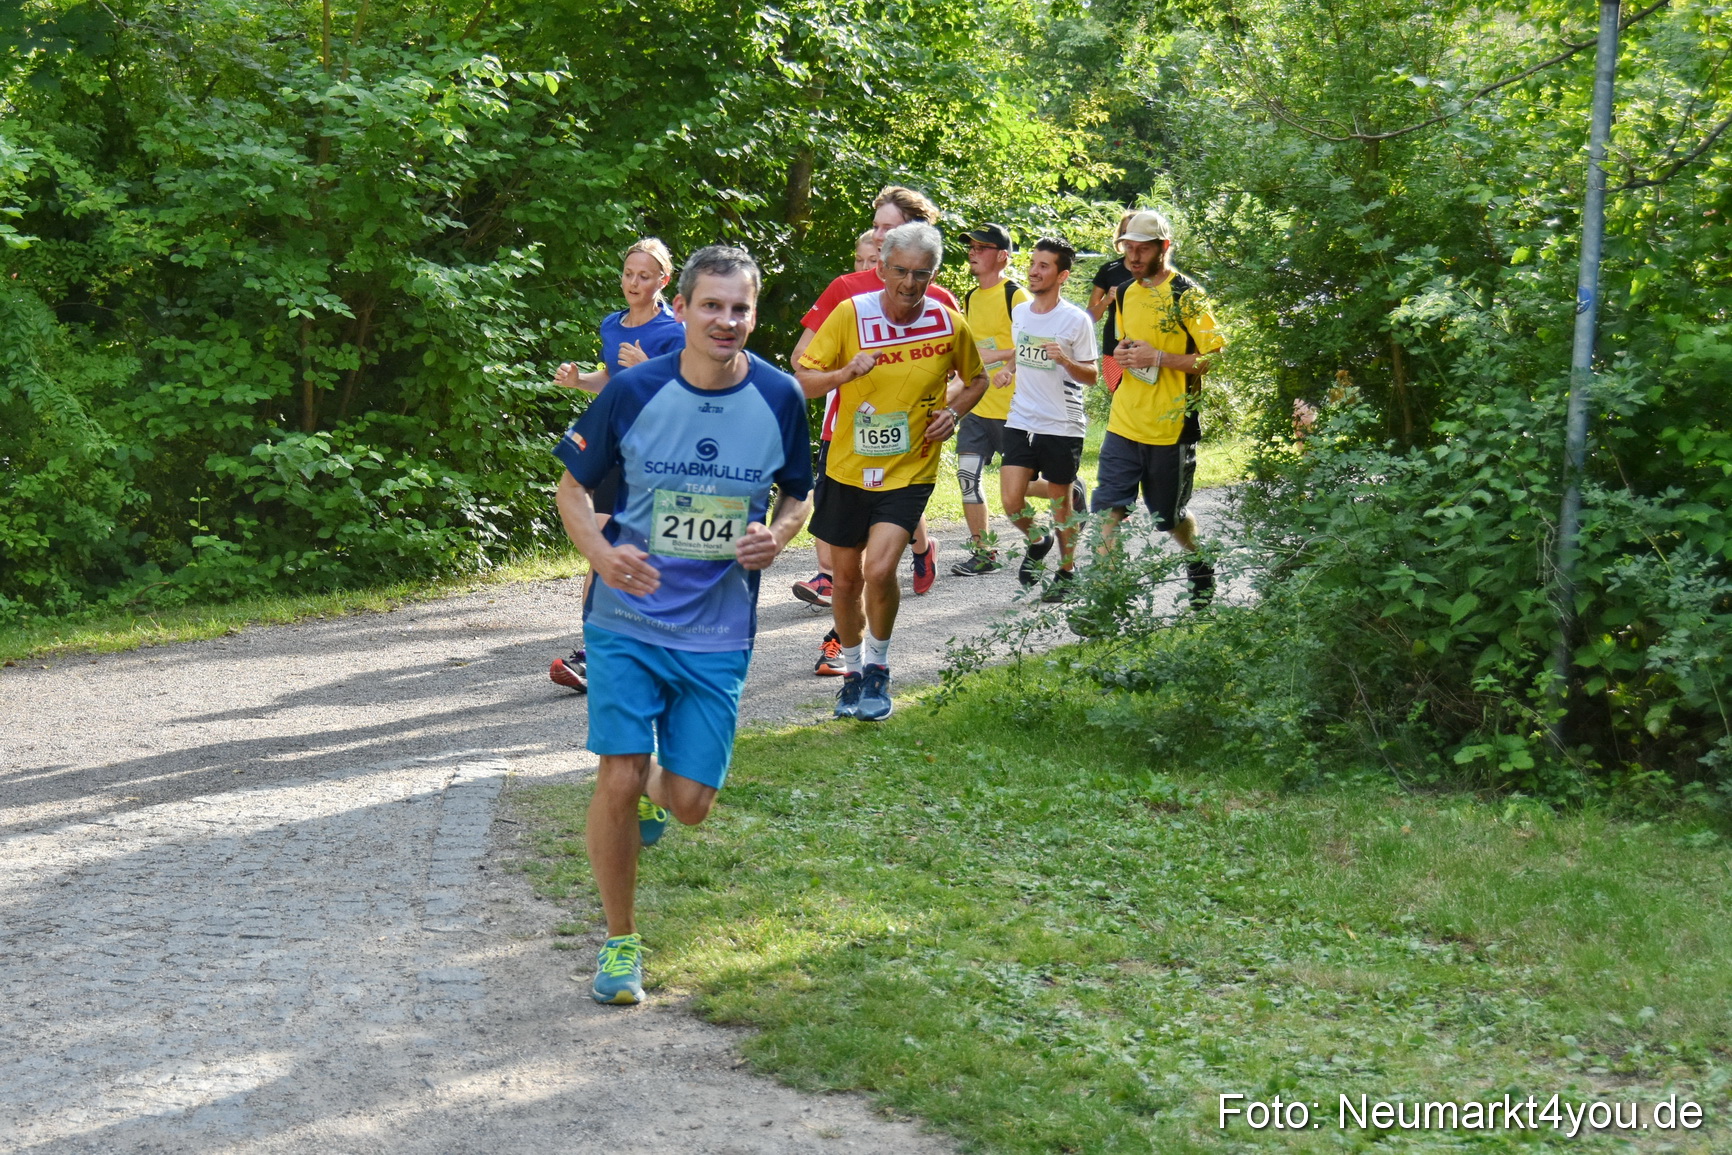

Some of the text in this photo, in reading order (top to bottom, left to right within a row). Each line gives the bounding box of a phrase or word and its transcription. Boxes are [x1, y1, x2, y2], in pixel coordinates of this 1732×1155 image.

[875, 351, 904, 367] AX
[1019, 344, 1048, 361] 2170
[859, 427, 901, 445] 1659
[644, 461, 762, 483] SCHABMÜLLER
[685, 483, 717, 494] TEAM
[662, 515, 733, 542] 2104
[614, 608, 730, 634] www.schabmueller.de
